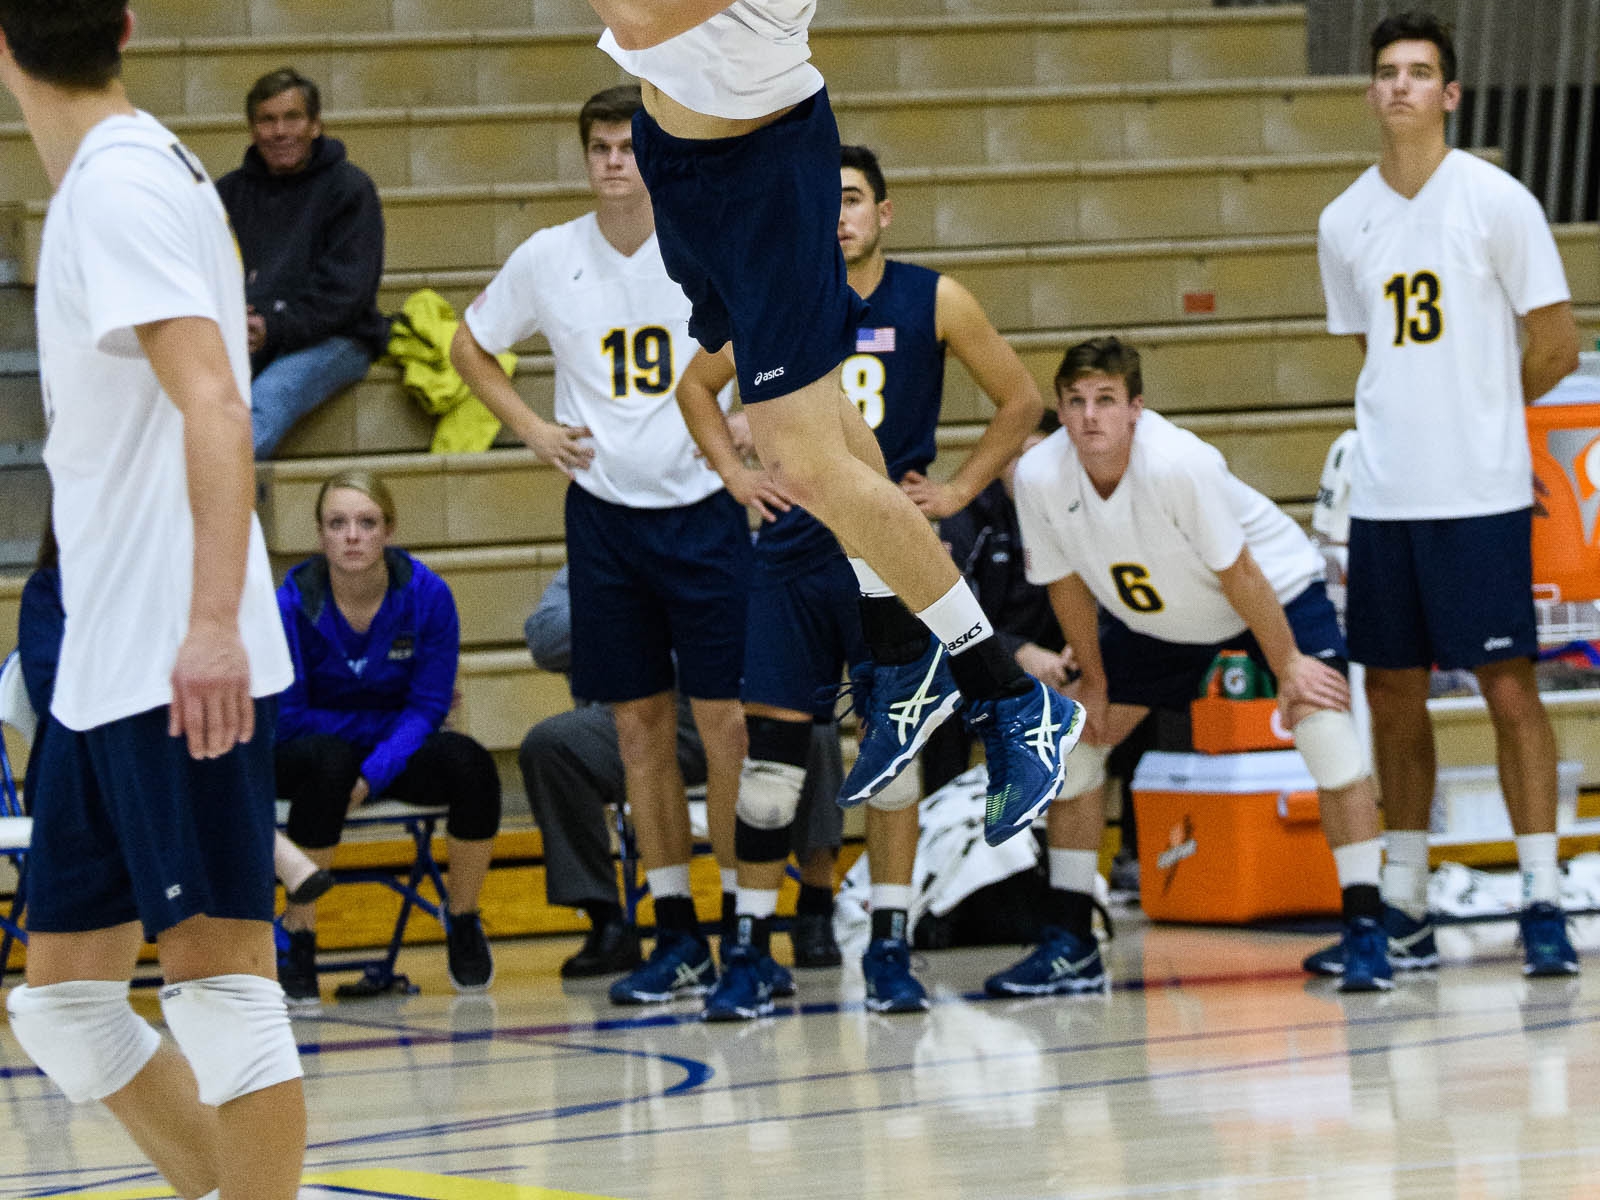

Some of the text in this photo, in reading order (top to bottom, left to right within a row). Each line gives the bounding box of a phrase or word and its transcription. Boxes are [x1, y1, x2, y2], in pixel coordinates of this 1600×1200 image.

[1384, 270, 1444, 346] 13
[601, 325, 674, 398] 19
[841, 353, 886, 430] 8
[1109, 563, 1166, 614] 6
